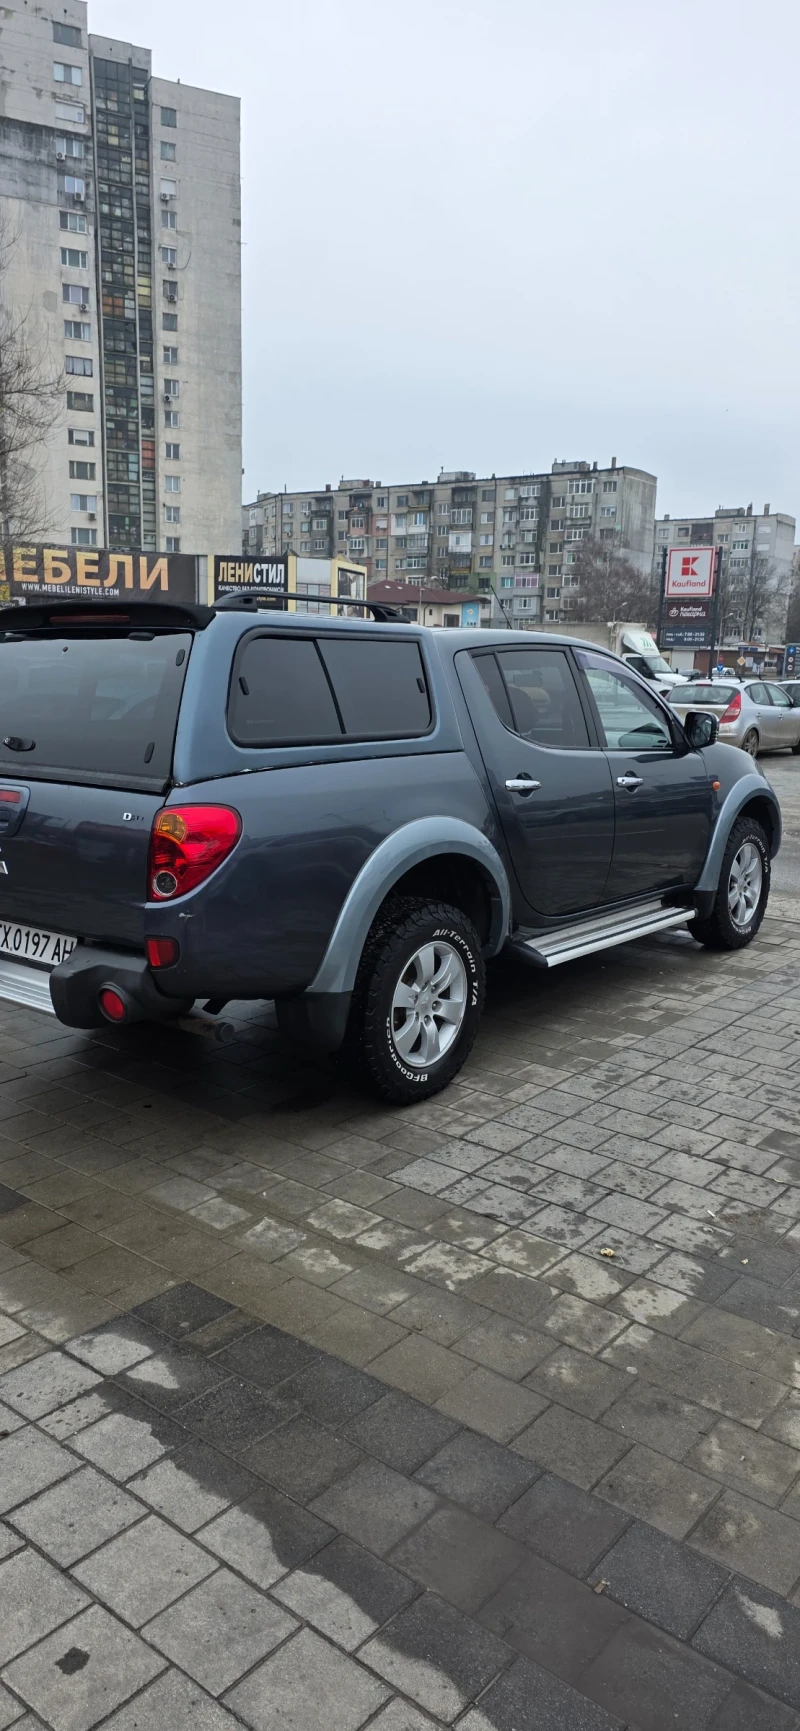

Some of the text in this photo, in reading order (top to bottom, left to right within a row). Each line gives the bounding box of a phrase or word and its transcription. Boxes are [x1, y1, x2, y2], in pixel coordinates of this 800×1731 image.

[0, 546, 169, 591] ЕБЕЛИ
[218, 561, 285, 584] ЛЕНИСТИЛ
[672, 580, 706, 588] Kaufland
[21, 583, 120, 596] WWW.MEBELILENISTYLE.COM
[432, 928, 479, 1007] All-Terrain T/A
[386, 1016, 429, 1082] BFGoodrich
